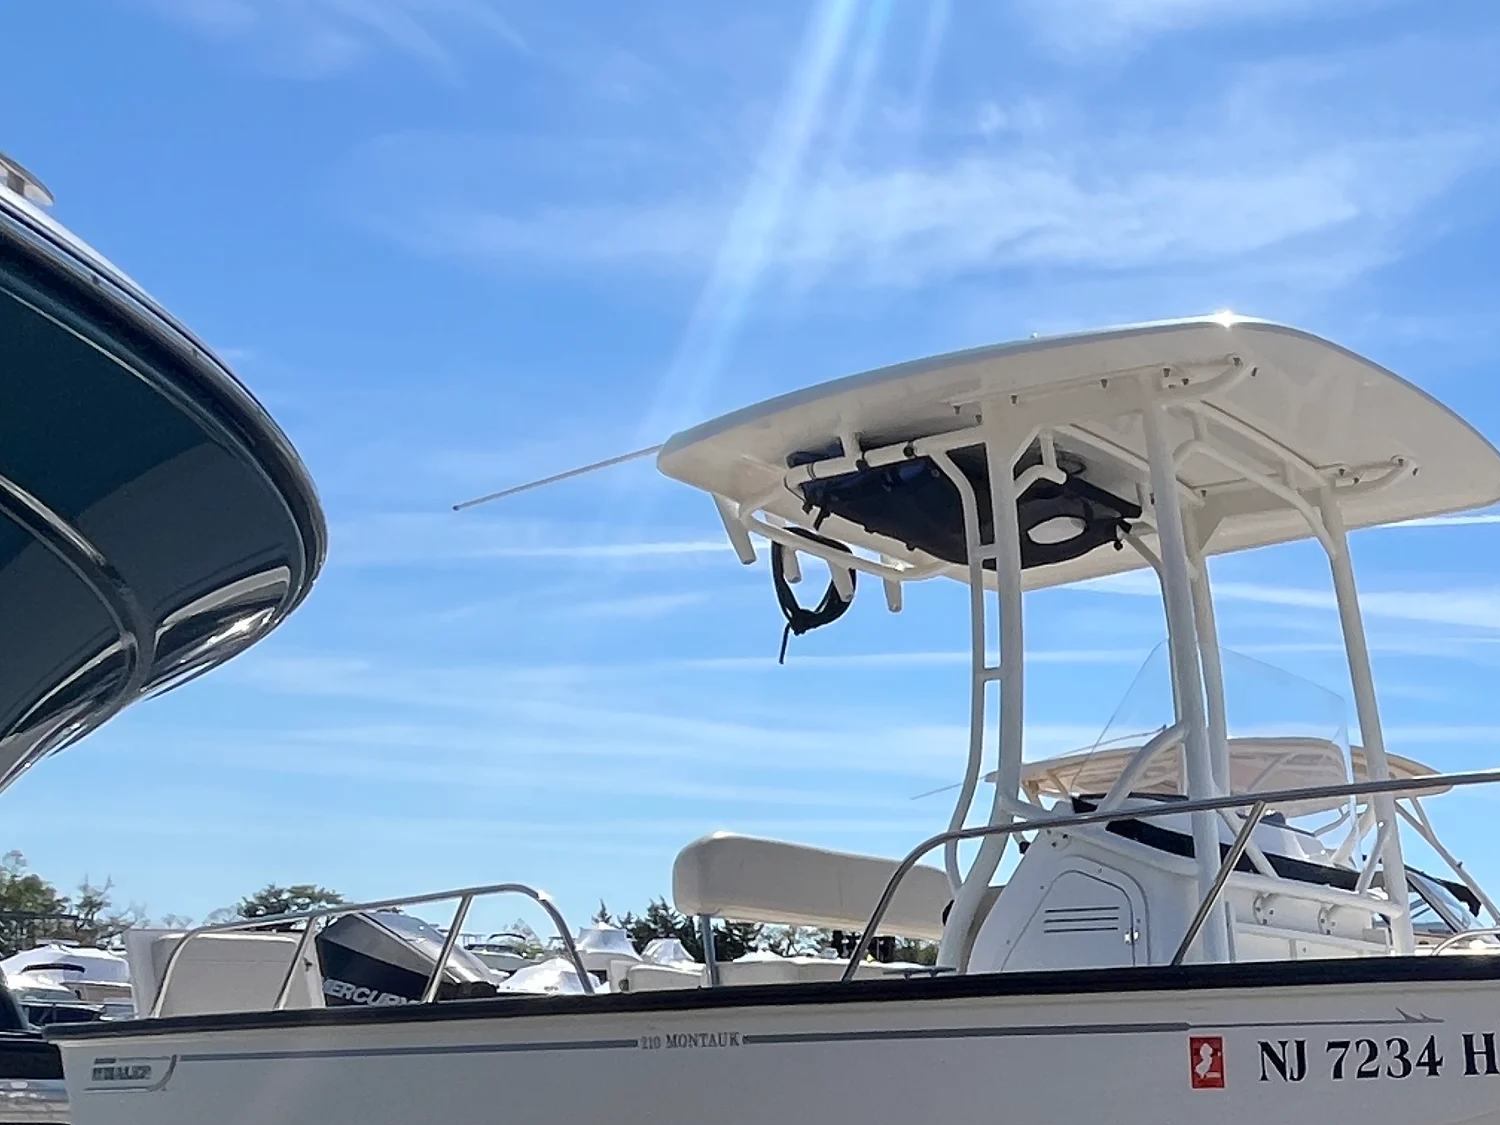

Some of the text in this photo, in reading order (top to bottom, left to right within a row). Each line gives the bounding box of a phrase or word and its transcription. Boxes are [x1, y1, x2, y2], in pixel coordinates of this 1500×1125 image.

[641, 1032, 740, 1050] 210 MONTAUK
[1257, 1039, 1307, 1083] NJ
[1325, 1034, 1444, 1080] 7234
